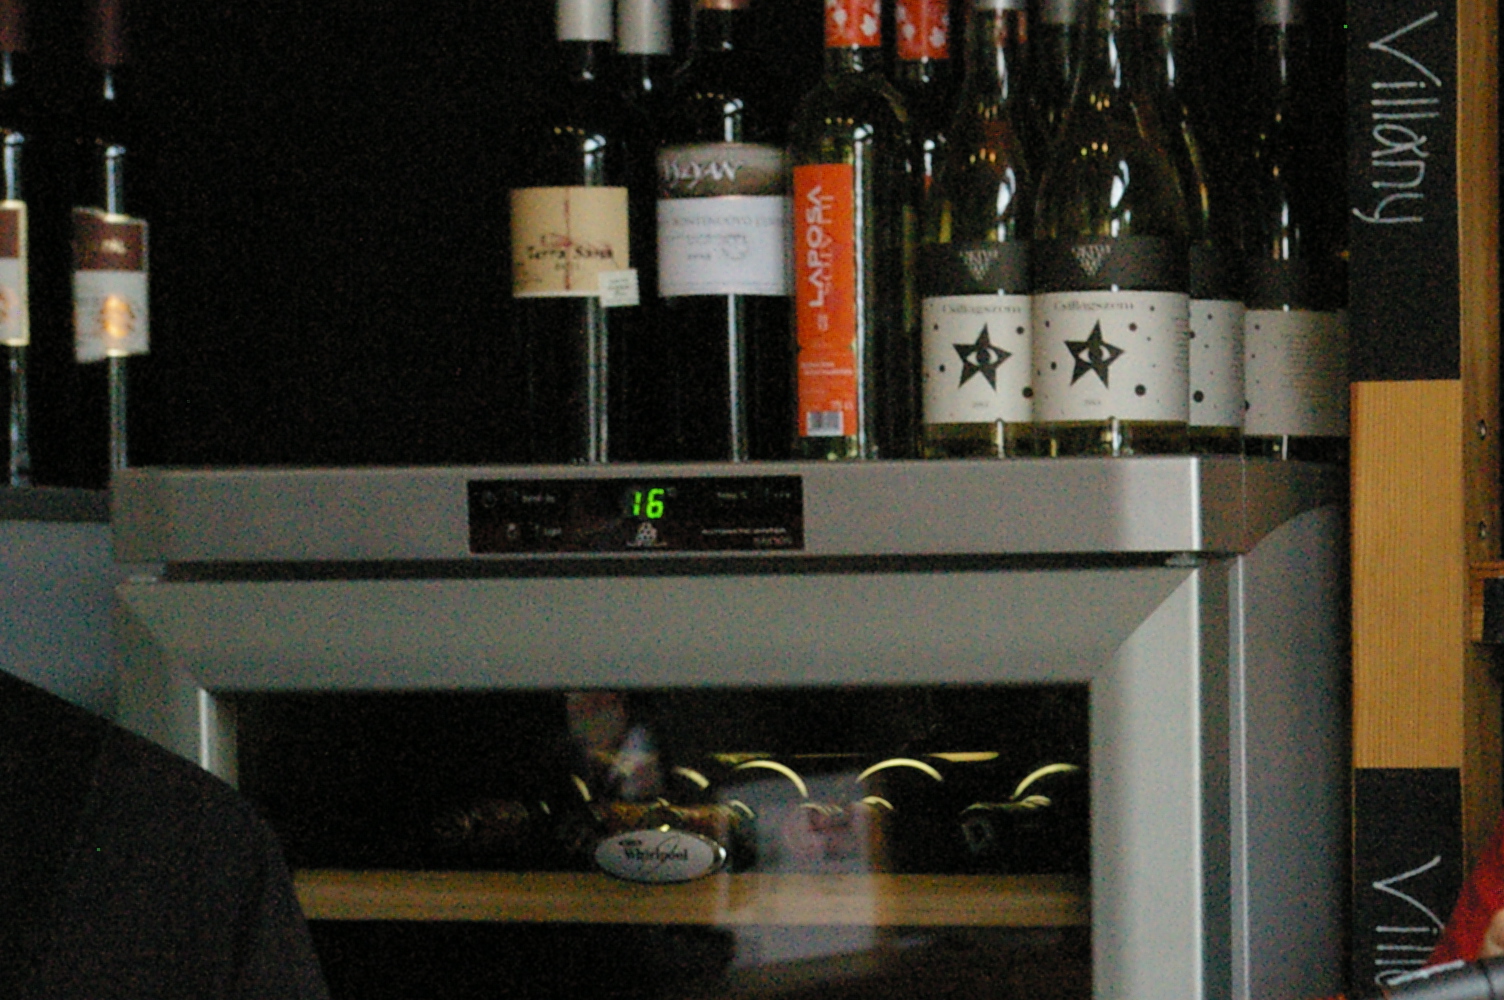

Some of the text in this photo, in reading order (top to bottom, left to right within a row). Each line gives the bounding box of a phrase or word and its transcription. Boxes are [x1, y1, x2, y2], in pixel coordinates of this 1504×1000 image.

[805, 185, 825, 307] LAPOSA
[632, 487, 665, 519] 16
[623, 843, 690, 864] Whirlpool
